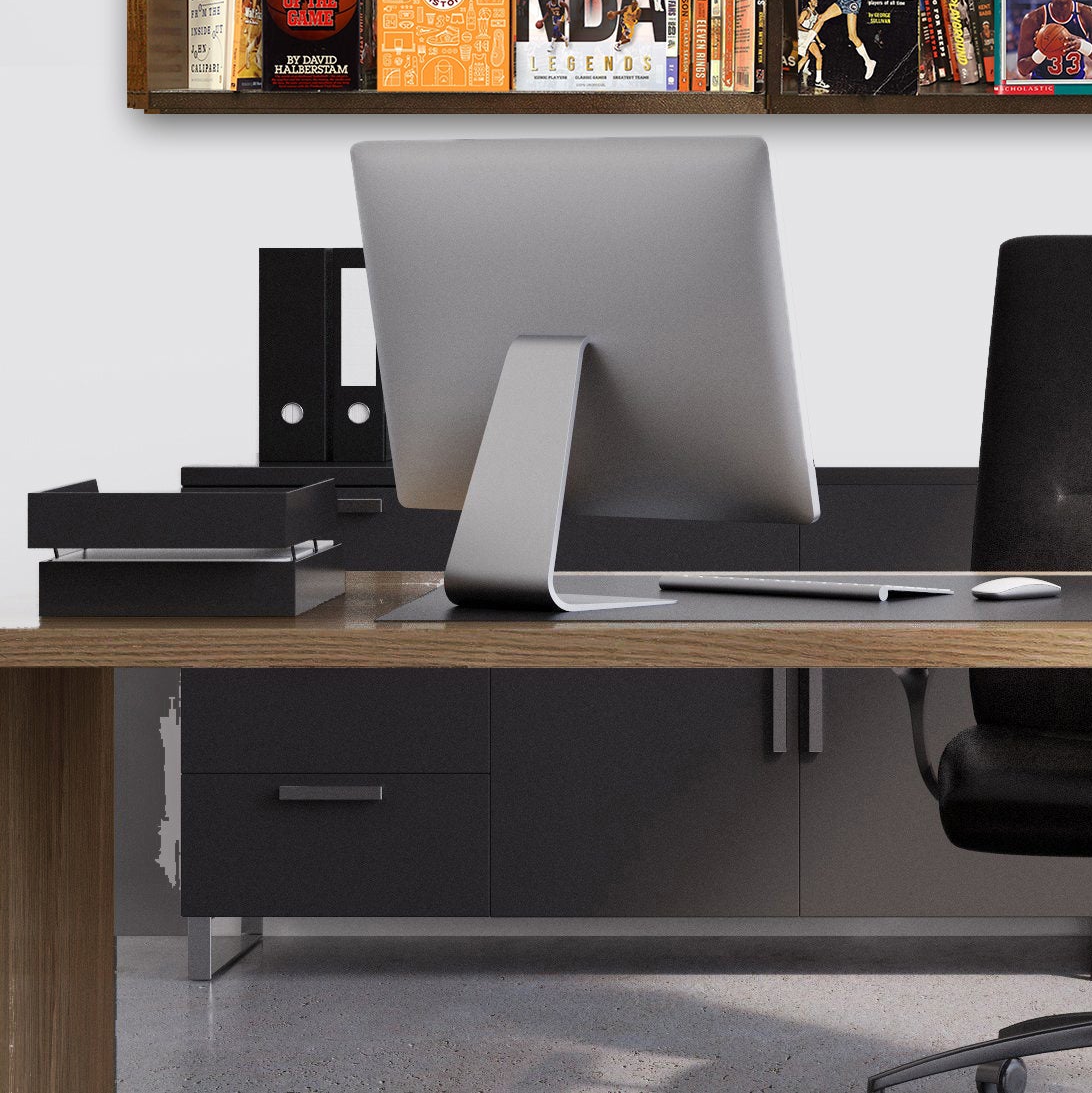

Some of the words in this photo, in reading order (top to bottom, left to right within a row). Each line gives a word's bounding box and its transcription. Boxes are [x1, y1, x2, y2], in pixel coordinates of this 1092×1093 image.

[287, 11, 334, 26] GAME
[287, 56, 300, 64] BY
[303, 56, 337, 64] DAVID
[530, 56, 652, 71] LEGENDS
[275, 65, 348, 74] HALBERSTAM
